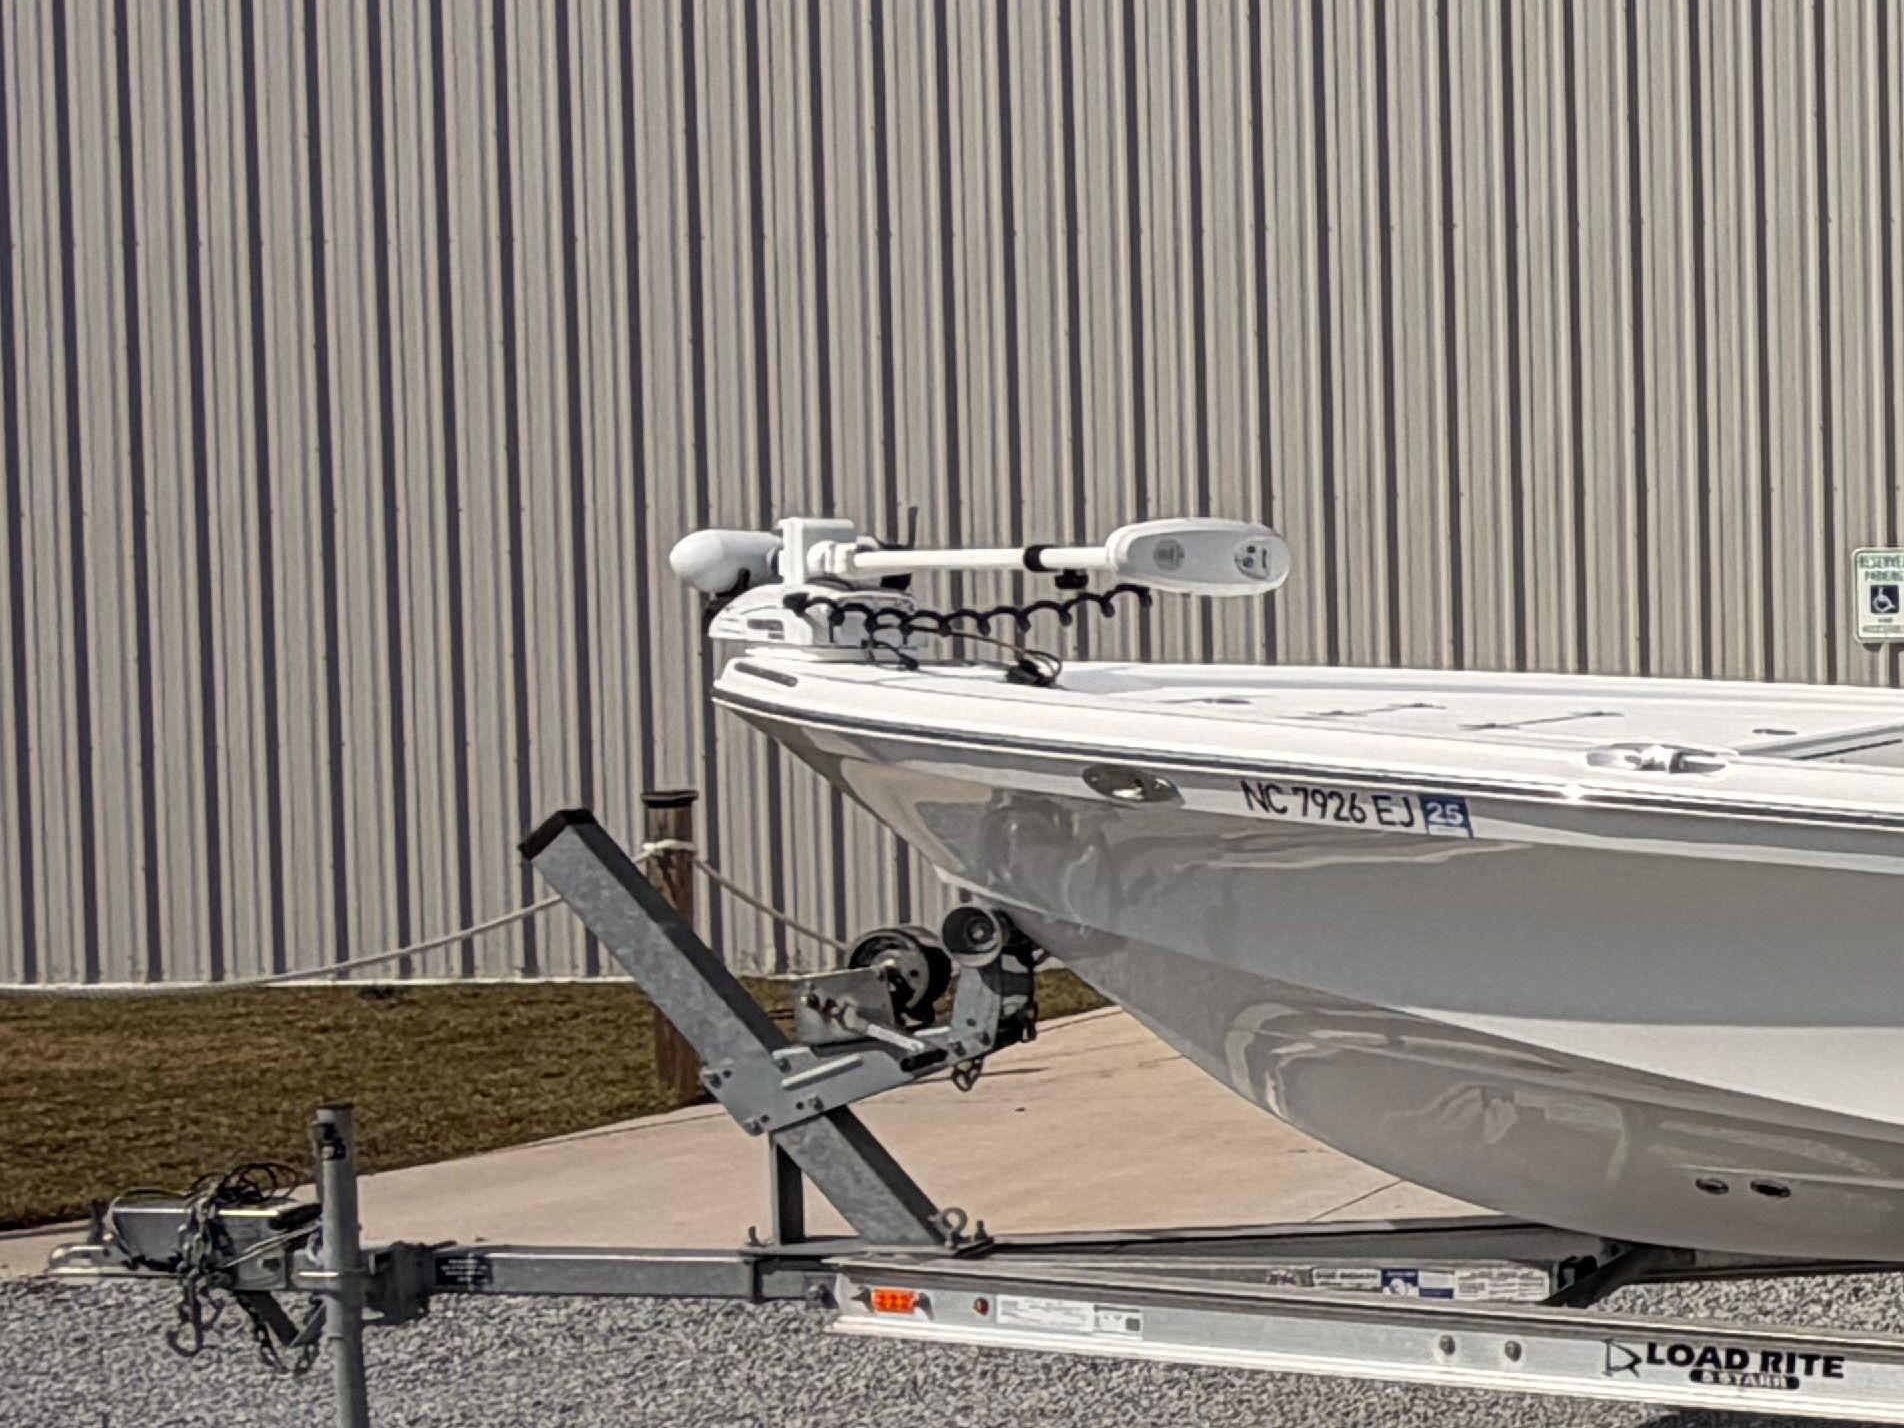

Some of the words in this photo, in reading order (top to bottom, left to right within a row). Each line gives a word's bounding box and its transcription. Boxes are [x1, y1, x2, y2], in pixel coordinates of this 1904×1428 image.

[1240, 779, 1288, 816] NC
[1291, 785, 1368, 824] 7926
[1370, 793, 1416, 828] EJ
[1425, 801, 1465, 827] 25
[1646, 1341, 1750, 1371] LOAD
[1759, 1350, 1846, 1379] RITE
